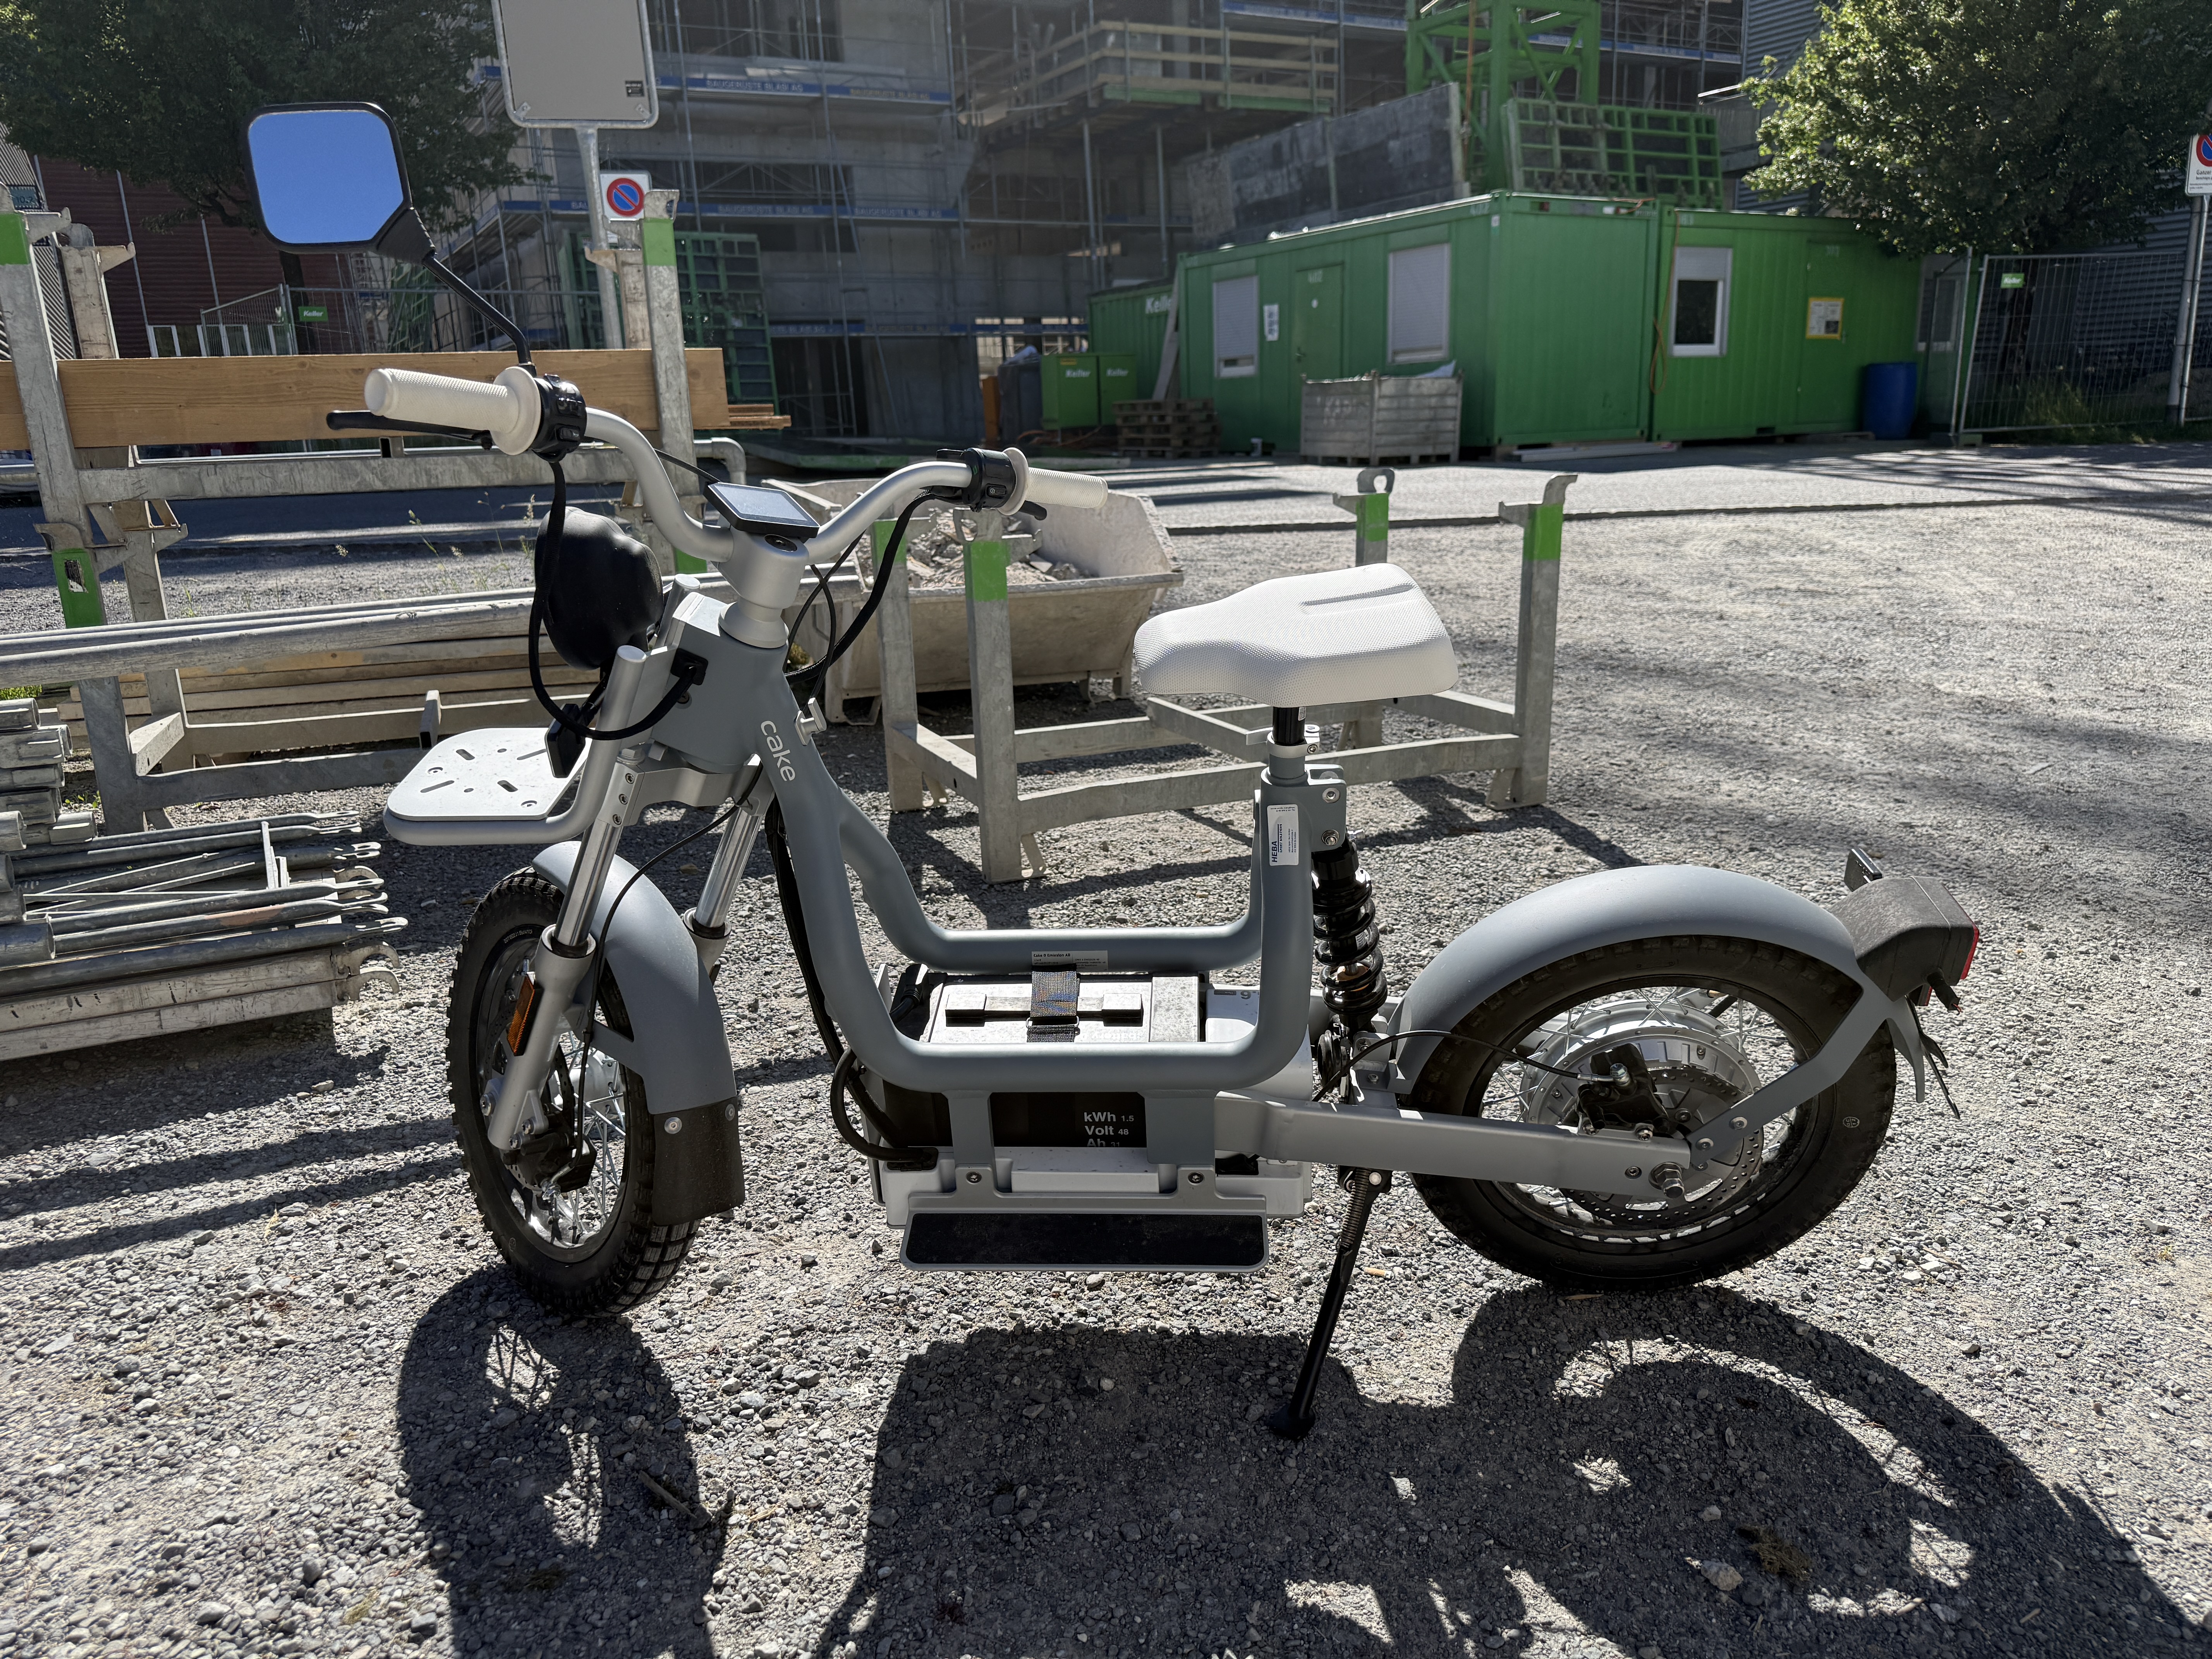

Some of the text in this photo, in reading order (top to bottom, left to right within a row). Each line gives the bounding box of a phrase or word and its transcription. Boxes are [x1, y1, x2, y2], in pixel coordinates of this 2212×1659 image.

[1066, 369, 1091, 378] Keller
[1106, 368, 1128, 377] Keller
[761, 721, 795, 781] cake
[1084, 1112, 1116, 1122] kWh
[1084, 1125, 1114, 1135] Volt
[1087, 1138, 1106, 1147] Ah
